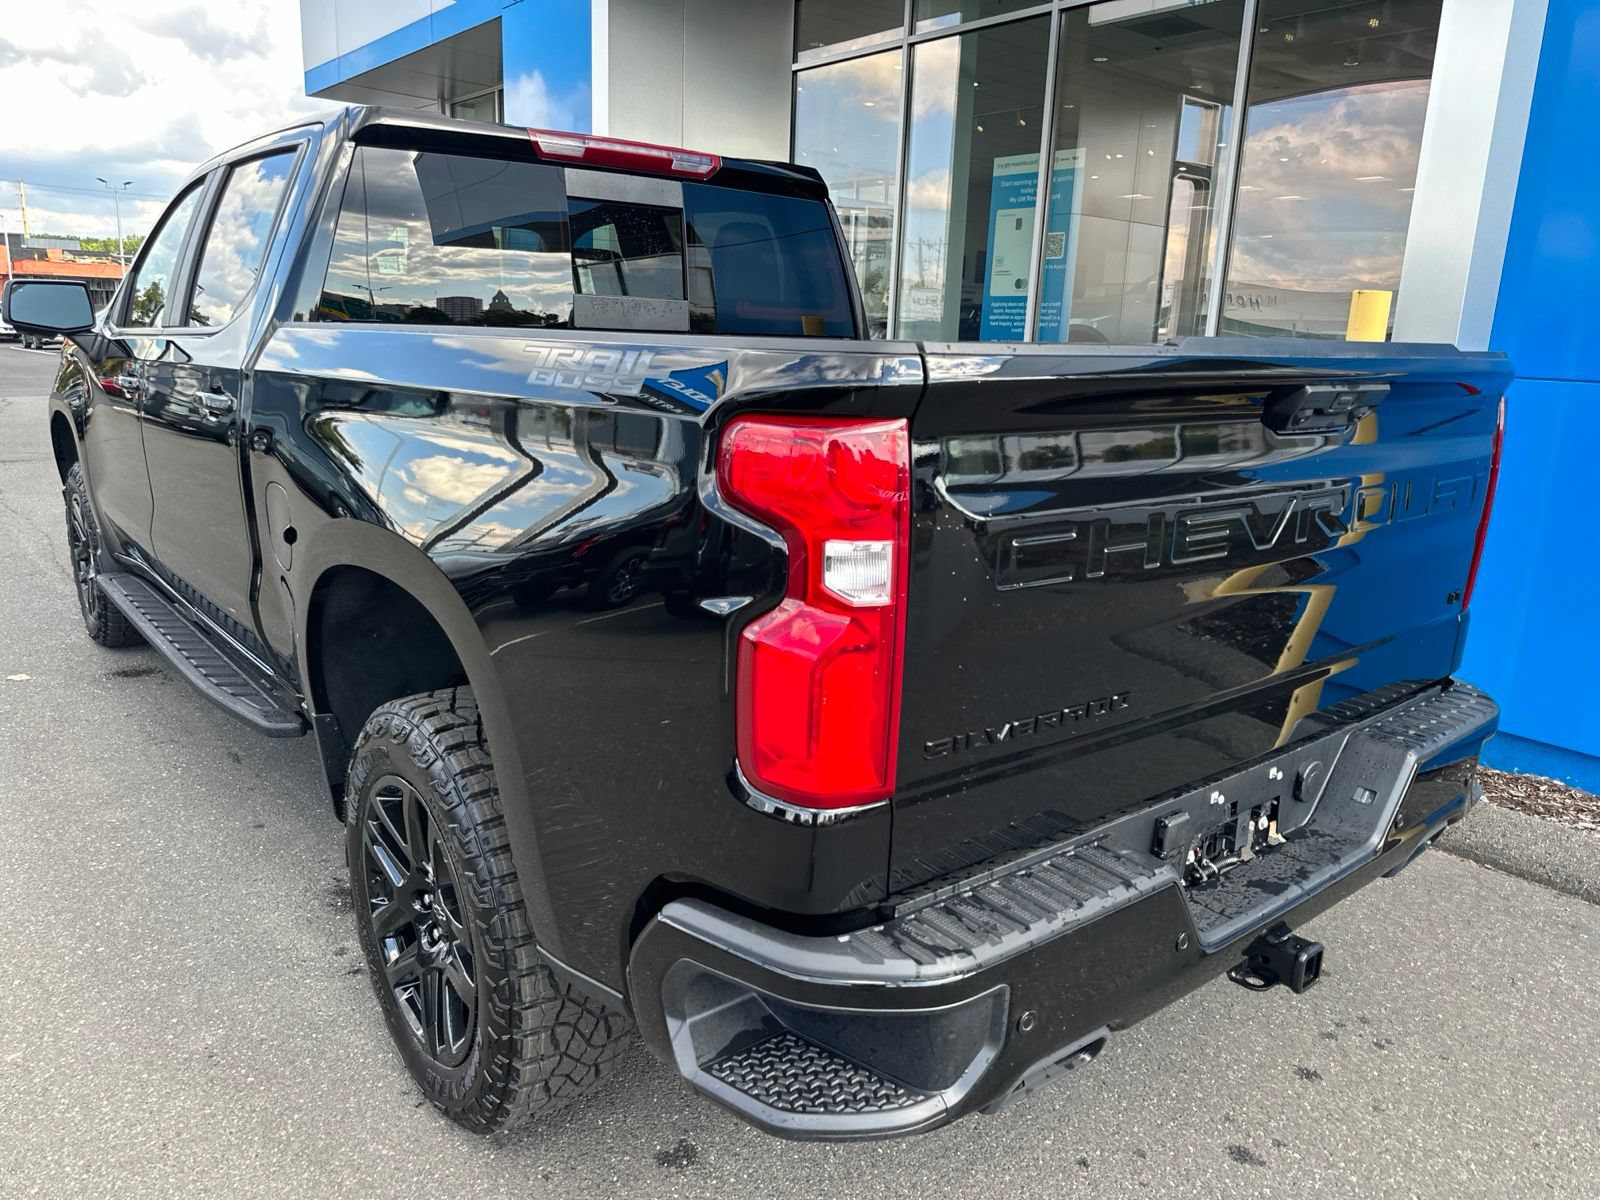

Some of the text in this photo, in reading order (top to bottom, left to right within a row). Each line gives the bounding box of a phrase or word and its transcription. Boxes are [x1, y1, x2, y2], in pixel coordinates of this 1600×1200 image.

[523, 344, 655, 376] TRAIL
[526, 366, 645, 396] BOSS
[995, 472, 1484, 591] CHEVROLET
[924, 691, 1131, 760] SILVERADO
